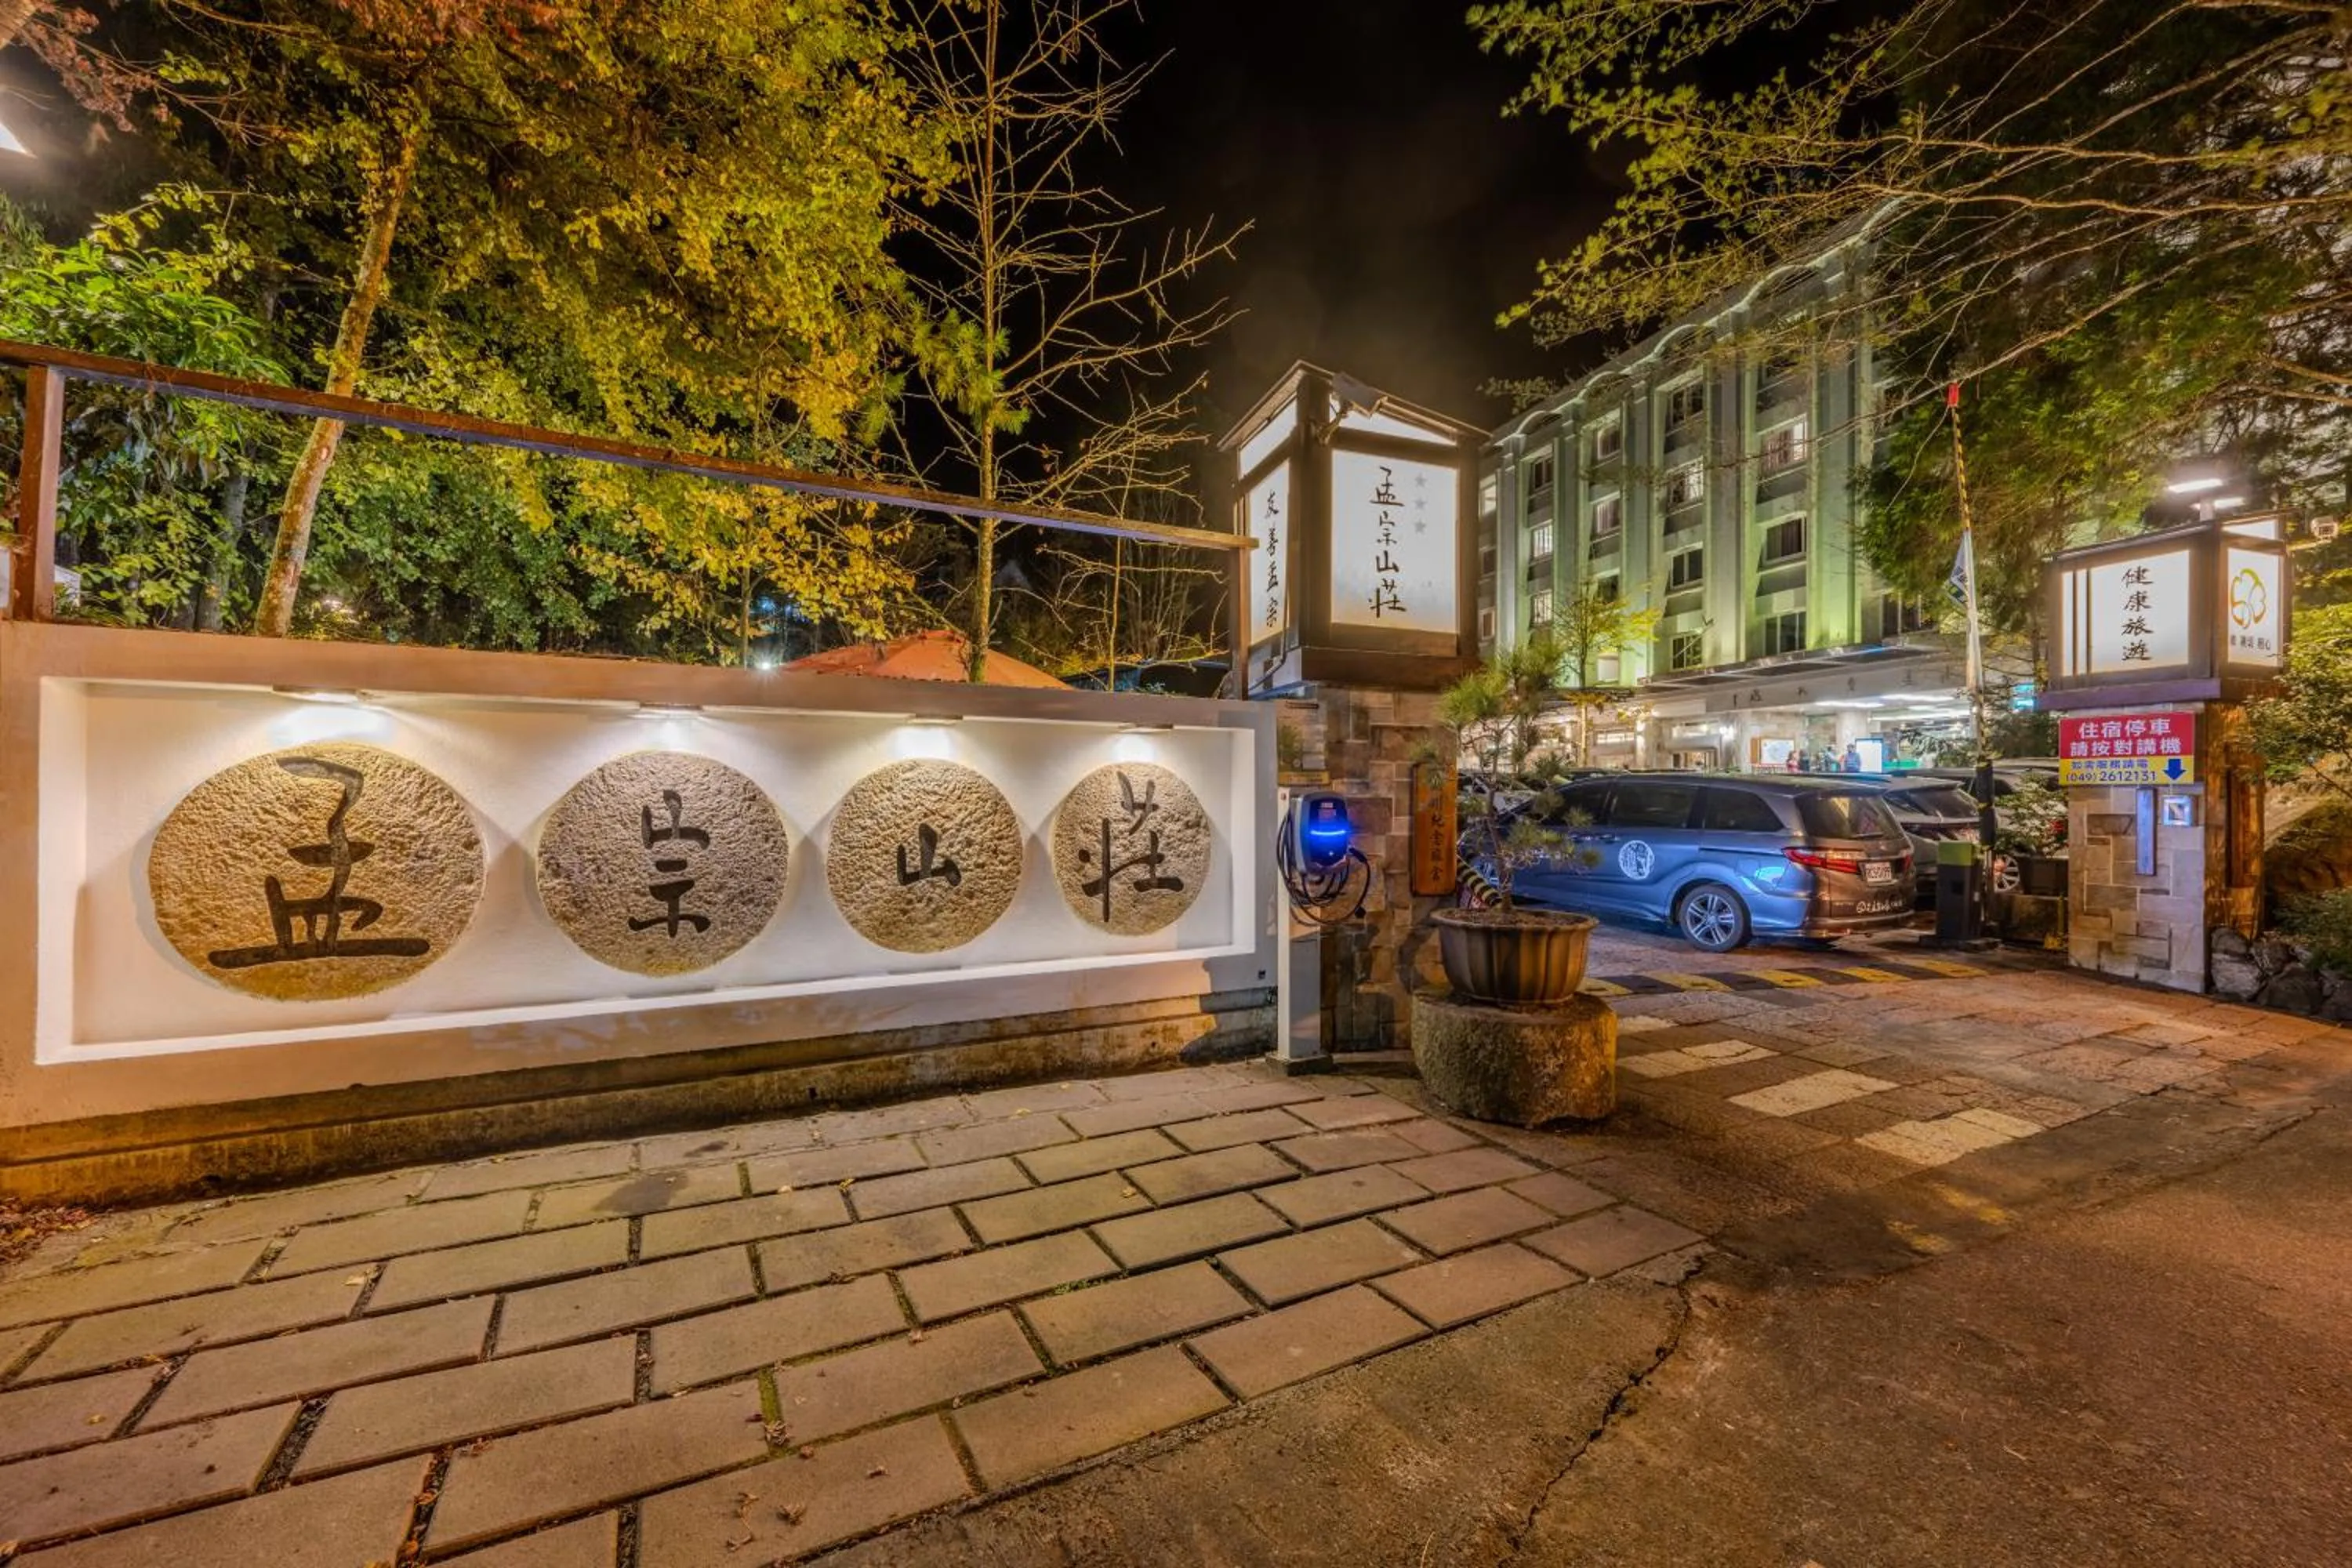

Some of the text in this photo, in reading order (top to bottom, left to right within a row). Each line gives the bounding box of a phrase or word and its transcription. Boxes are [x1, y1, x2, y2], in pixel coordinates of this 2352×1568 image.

[1368, 466, 1407, 619] 孟宗山莊
[2121, 564, 2154, 662] 健康旅遊
[2070, 737, 2182, 757] 請按對講機
[2079, 719, 2171, 739] 住宿停車
[207, 756, 1185, 969] 孟宗山莊
